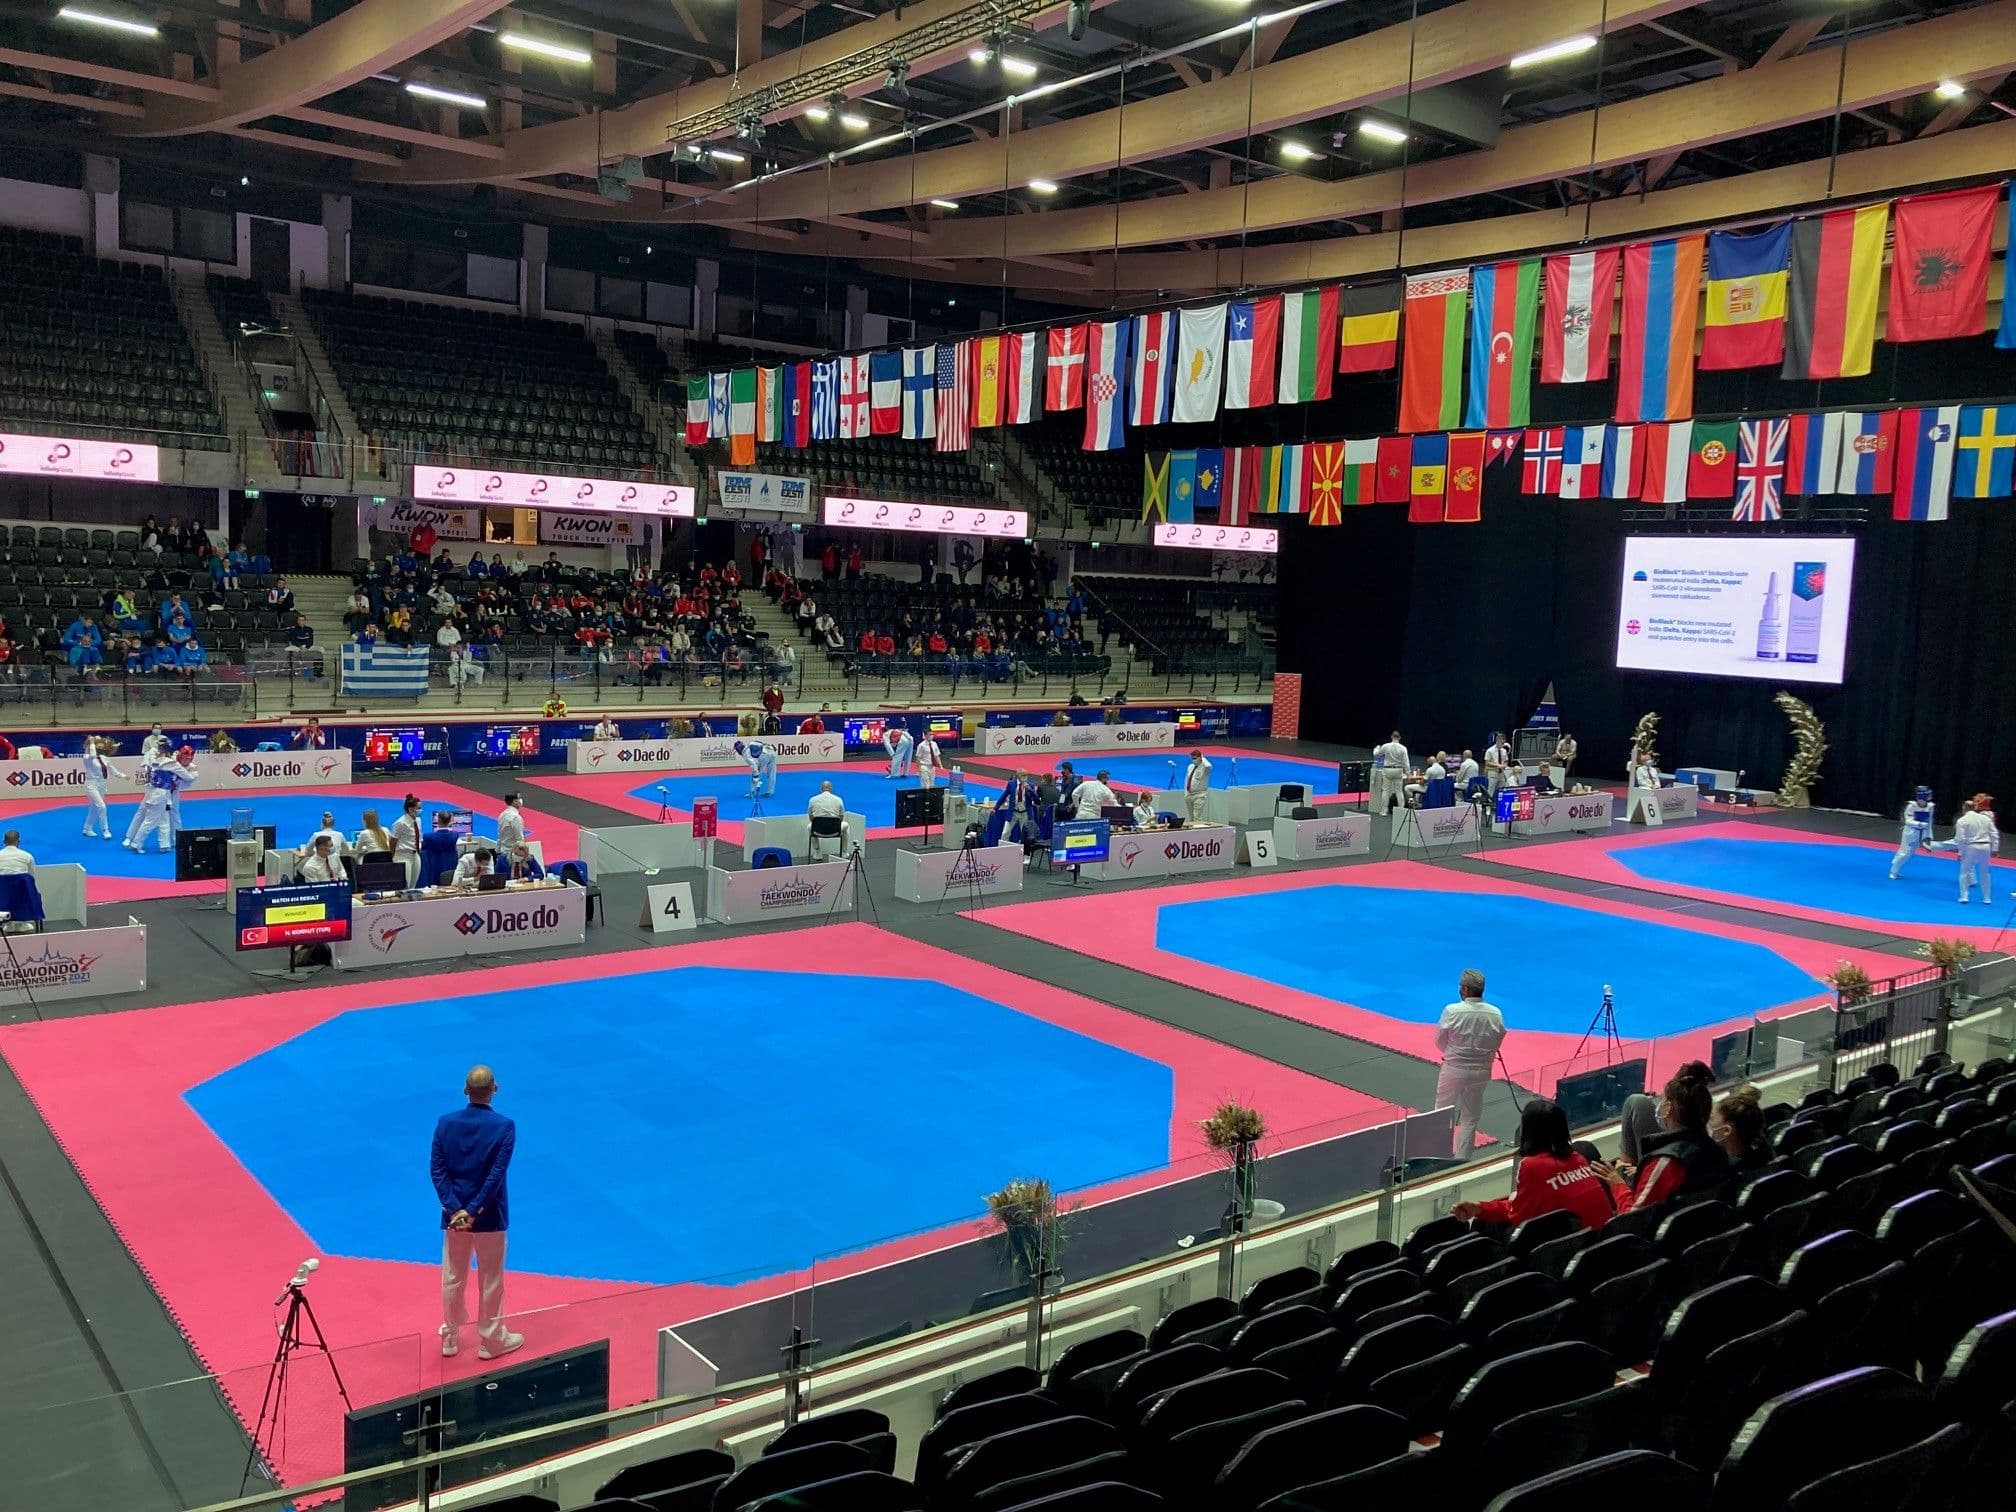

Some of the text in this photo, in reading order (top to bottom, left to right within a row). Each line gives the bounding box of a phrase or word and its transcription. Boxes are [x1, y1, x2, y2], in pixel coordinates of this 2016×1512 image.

[390, 505, 449, 524] KWON
[553, 516, 613, 533] KWON
[521, 737, 533, 747] 14
[1728, 793, 1737, 804] 3
[1647, 803, 1656, 818] 6
[1257, 840, 1268, 858] 5
[760, 888, 815, 901] TAEKWONDO
[664, 896, 681, 919] 4
